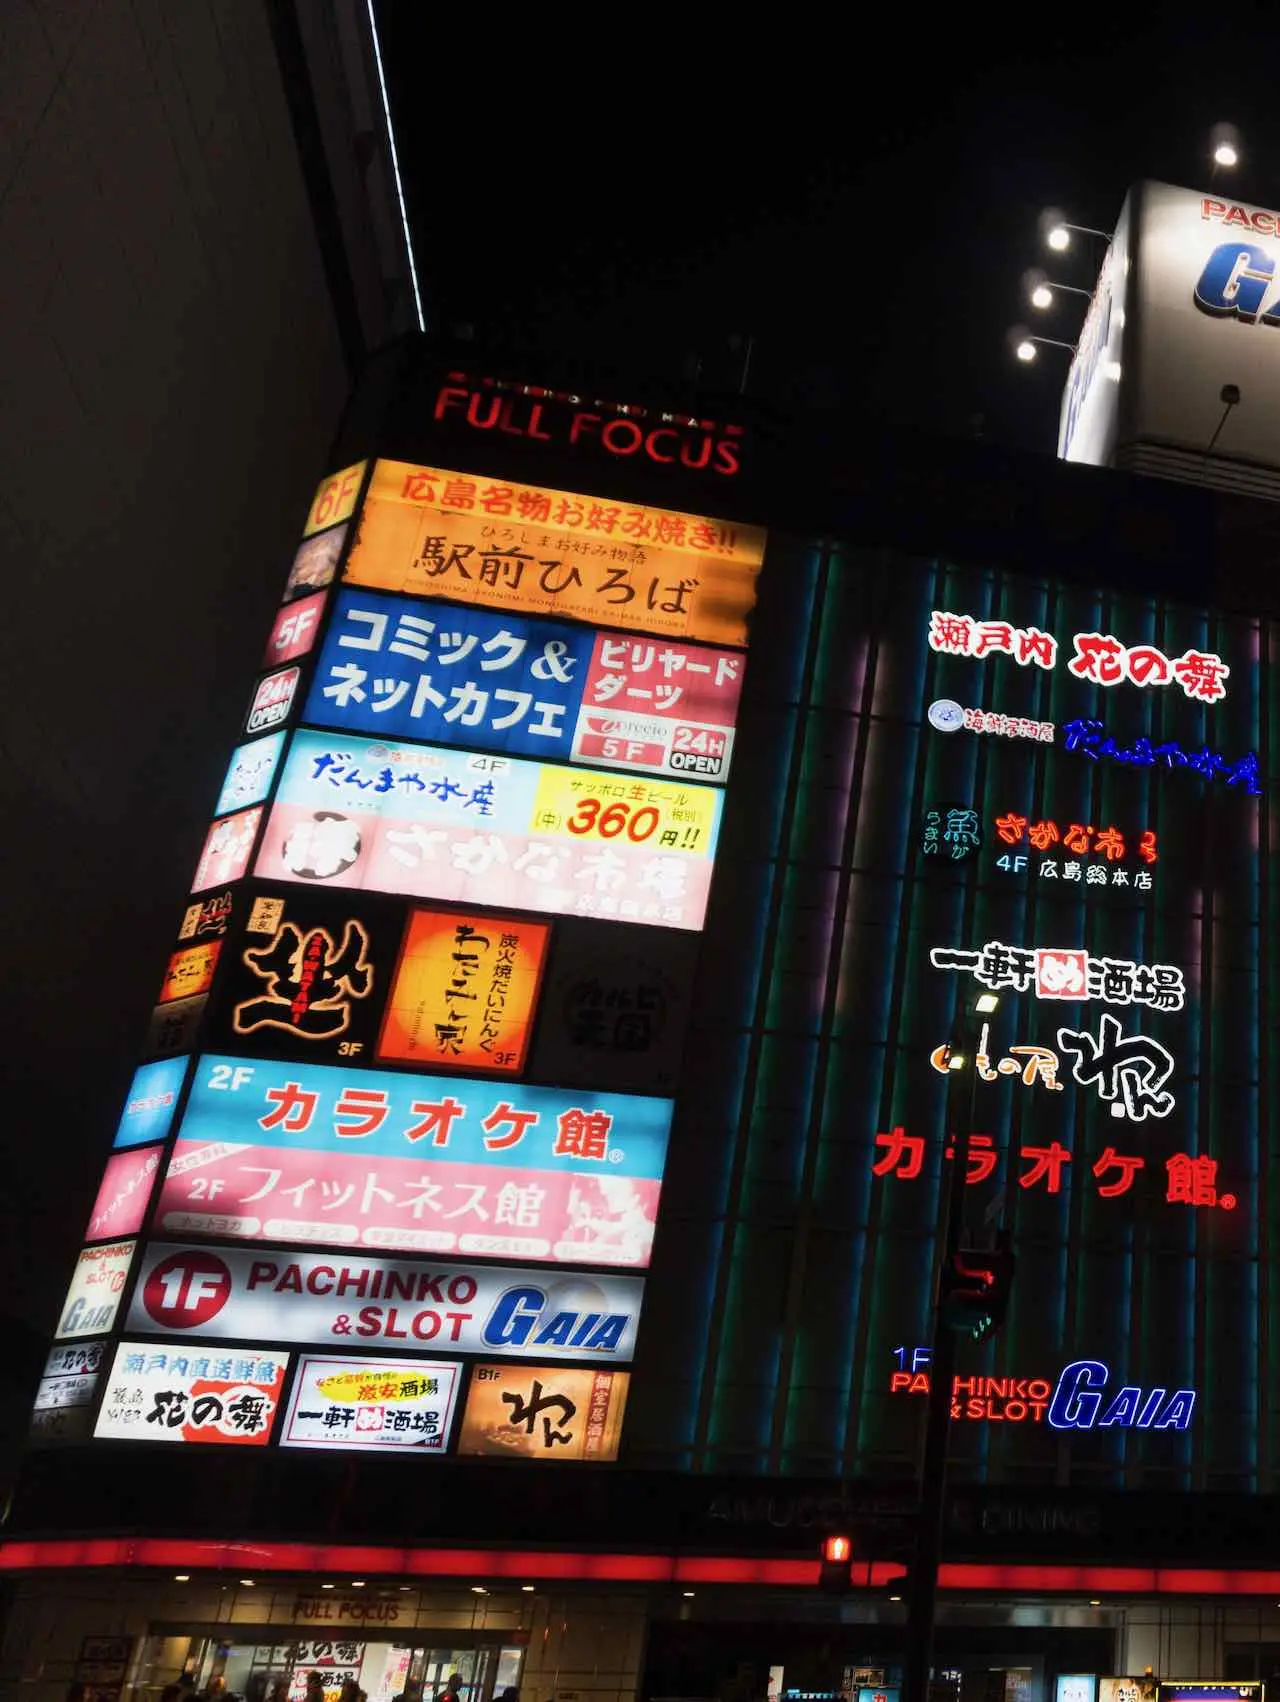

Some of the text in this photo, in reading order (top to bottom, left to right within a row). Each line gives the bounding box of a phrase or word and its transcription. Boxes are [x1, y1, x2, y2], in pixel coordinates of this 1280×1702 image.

[435, 386, 740, 475] FULL FOCUS
[314, 470, 359, 527] 6F
[413, 535, 700, 615] 駅前ひろば
[275, 607, 317, 650] 5F
[600, 639, 739, 686] ビリヤード
[928, 611, 1229, 703] 瀬戸内 花の舞
[254, 675, 295, 709] 24H
[323, 663, 567, 738] ネットカフェ
[594, 673, 683, 710] ダーツ
[250, 705, 290, 732] OPEN
[601, 739, 645, 760] 5F
[677, 727, 724, 756] 24H
[472, 758, 507, 772] 4F
[671, 753, 721, 775] OPEN
[312, 752, 495, 816] だんまや水産
[570, 780, 690, 806] サッポロ生ビール
[996, 854, 1152, 890] 4F 広島総本店
[479, 933, 520, 1053] 炭火焼だいにんぐ
[337, 1042, 365, 1057] 3F
[493, 1052, 517, 1066] 3F
[208, 1065, 254, 1091] 2F
[259, 1081, 614, 1160] カラオケ館
[872, 1127, 1217, 1206] カラオケ館
[187, 1178, 226, 1201] 2F
[238, 1166, 547, 1227] フィットネス館
[158, 1265, 229, 1311] 1F
[246, 1260, 478, 1306] PACHINKO
[482, 1283, 634, 1352] GAIA
[478, 1368, 502, 1381] B1F
[893, 1346, 931, 1373] 1F
[890, 1372, 1049, 1401] PAHINKO
[1048, 1360, 1196, 1430] GAIA
[146, 1390, 265, 1432] 花の舞
[293, 1602, 400, 1621] FULL FOCUS
